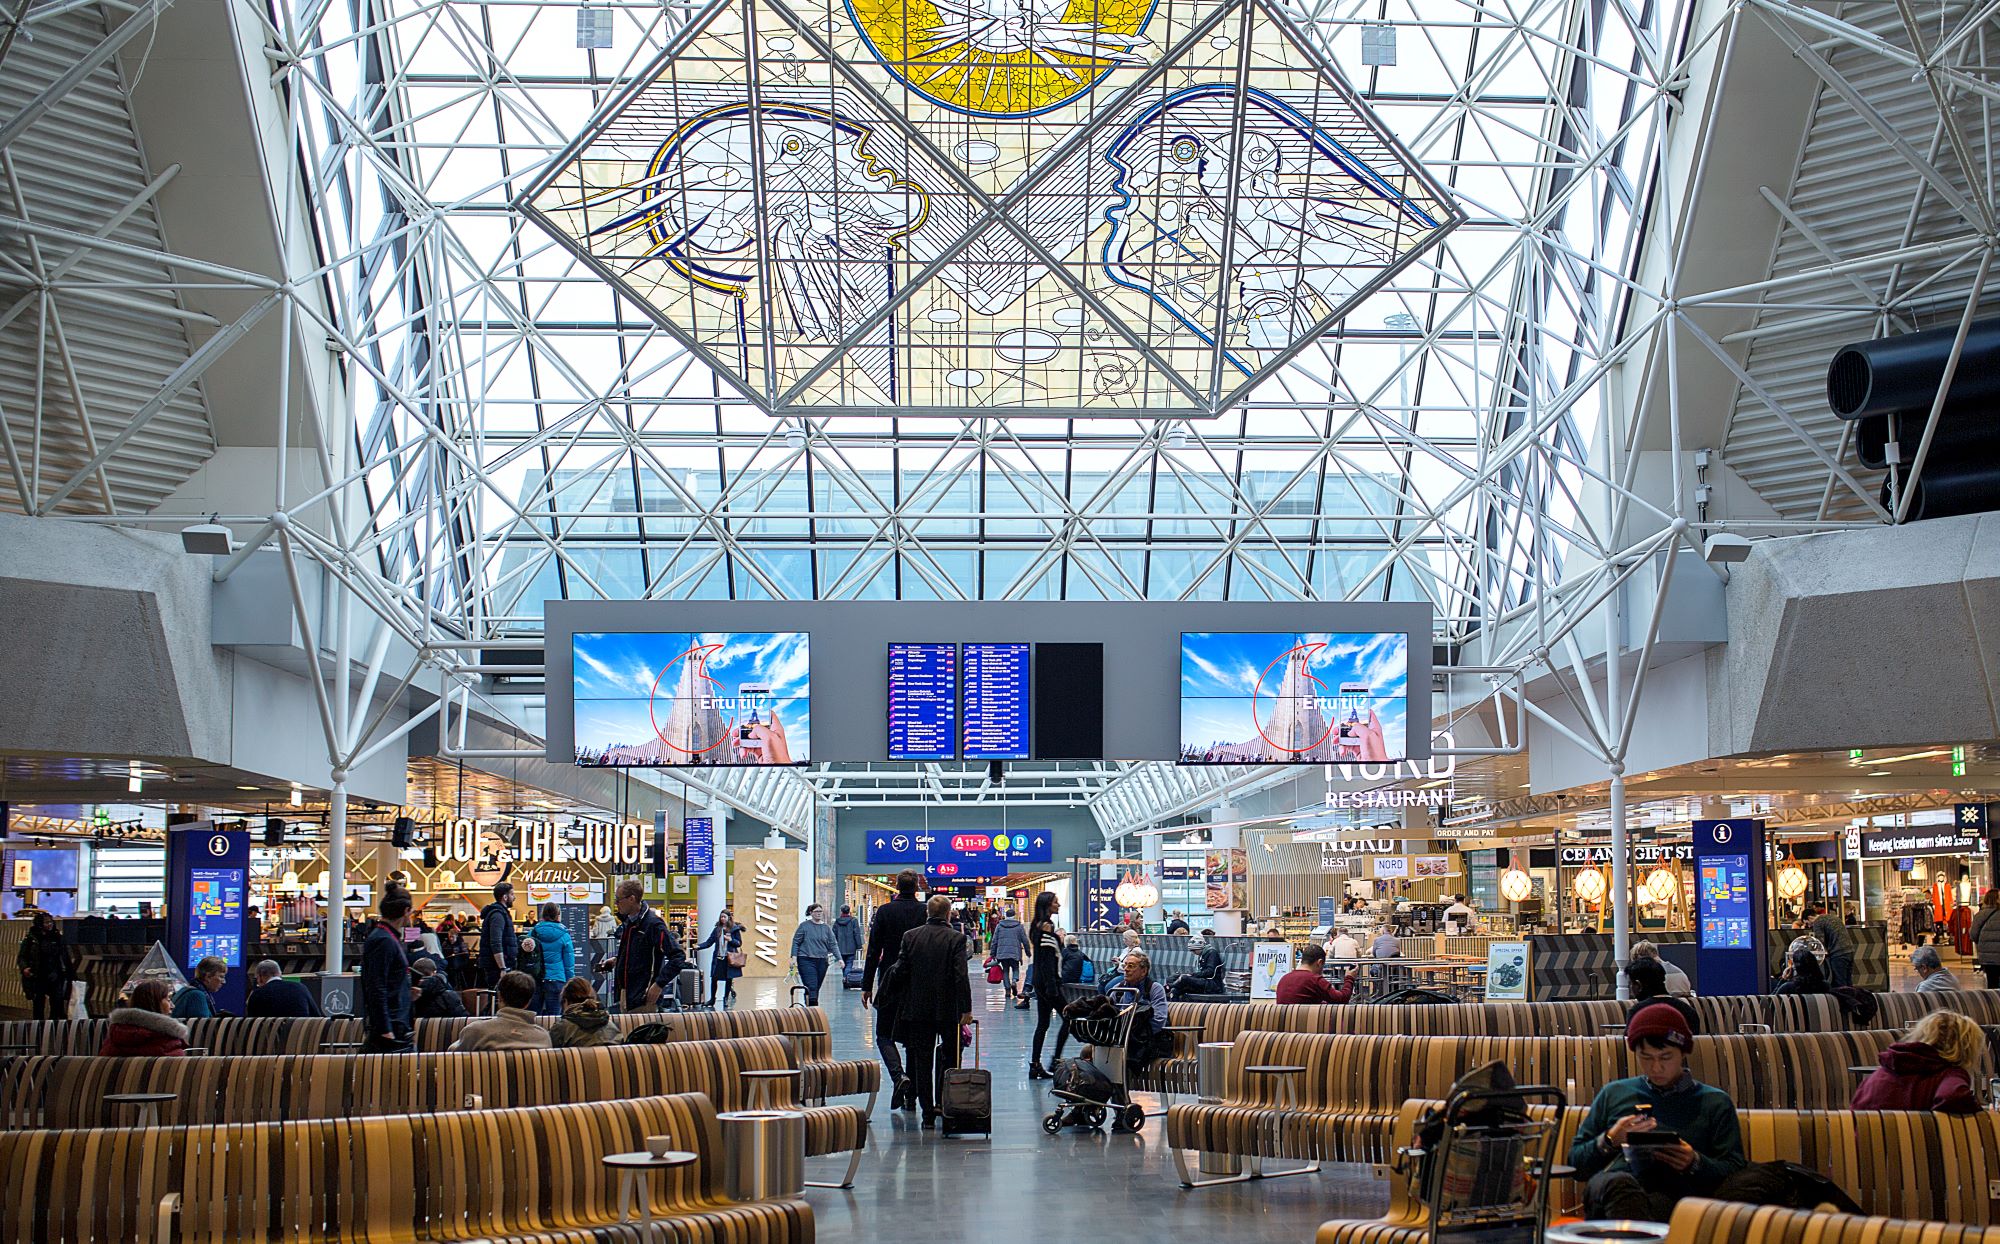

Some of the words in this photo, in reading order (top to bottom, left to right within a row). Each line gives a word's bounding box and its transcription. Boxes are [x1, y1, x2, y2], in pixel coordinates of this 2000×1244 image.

[700, 694, 736, 710] Ertu
[740, 693, 765, 710] til?
[1303, 694, 1339, 710] Ertu
[1340, 693, 1368, 710] til?
[1325, 788, 1456, 809] RESTAURANT
[915, 835, 935, 844] Gates
[1437, 829, 1462, 837] ORDER
[1464, 829, 1479, 837] AND
[1481, 829, 1495, 837] PAY
[435, 819, 492, 863] JOE
[497, 849, 515, 863] &
[515, 820, 570, 864] THE
[576, 823, 655, 864] JUICE
[966, 838, 987, 847] 11-16
[1016, 836, 1025, 848] D
[1868, 837, 1894, 854] Keeping
[1893, 835, 1916, 851] Iceland
[1916, 838, 1934, 849] warm
[1934, 833, 1952, 848] since
[1634, 846, 1674, 860] GIFT
[1378, 859, 1403, 869] NORD
